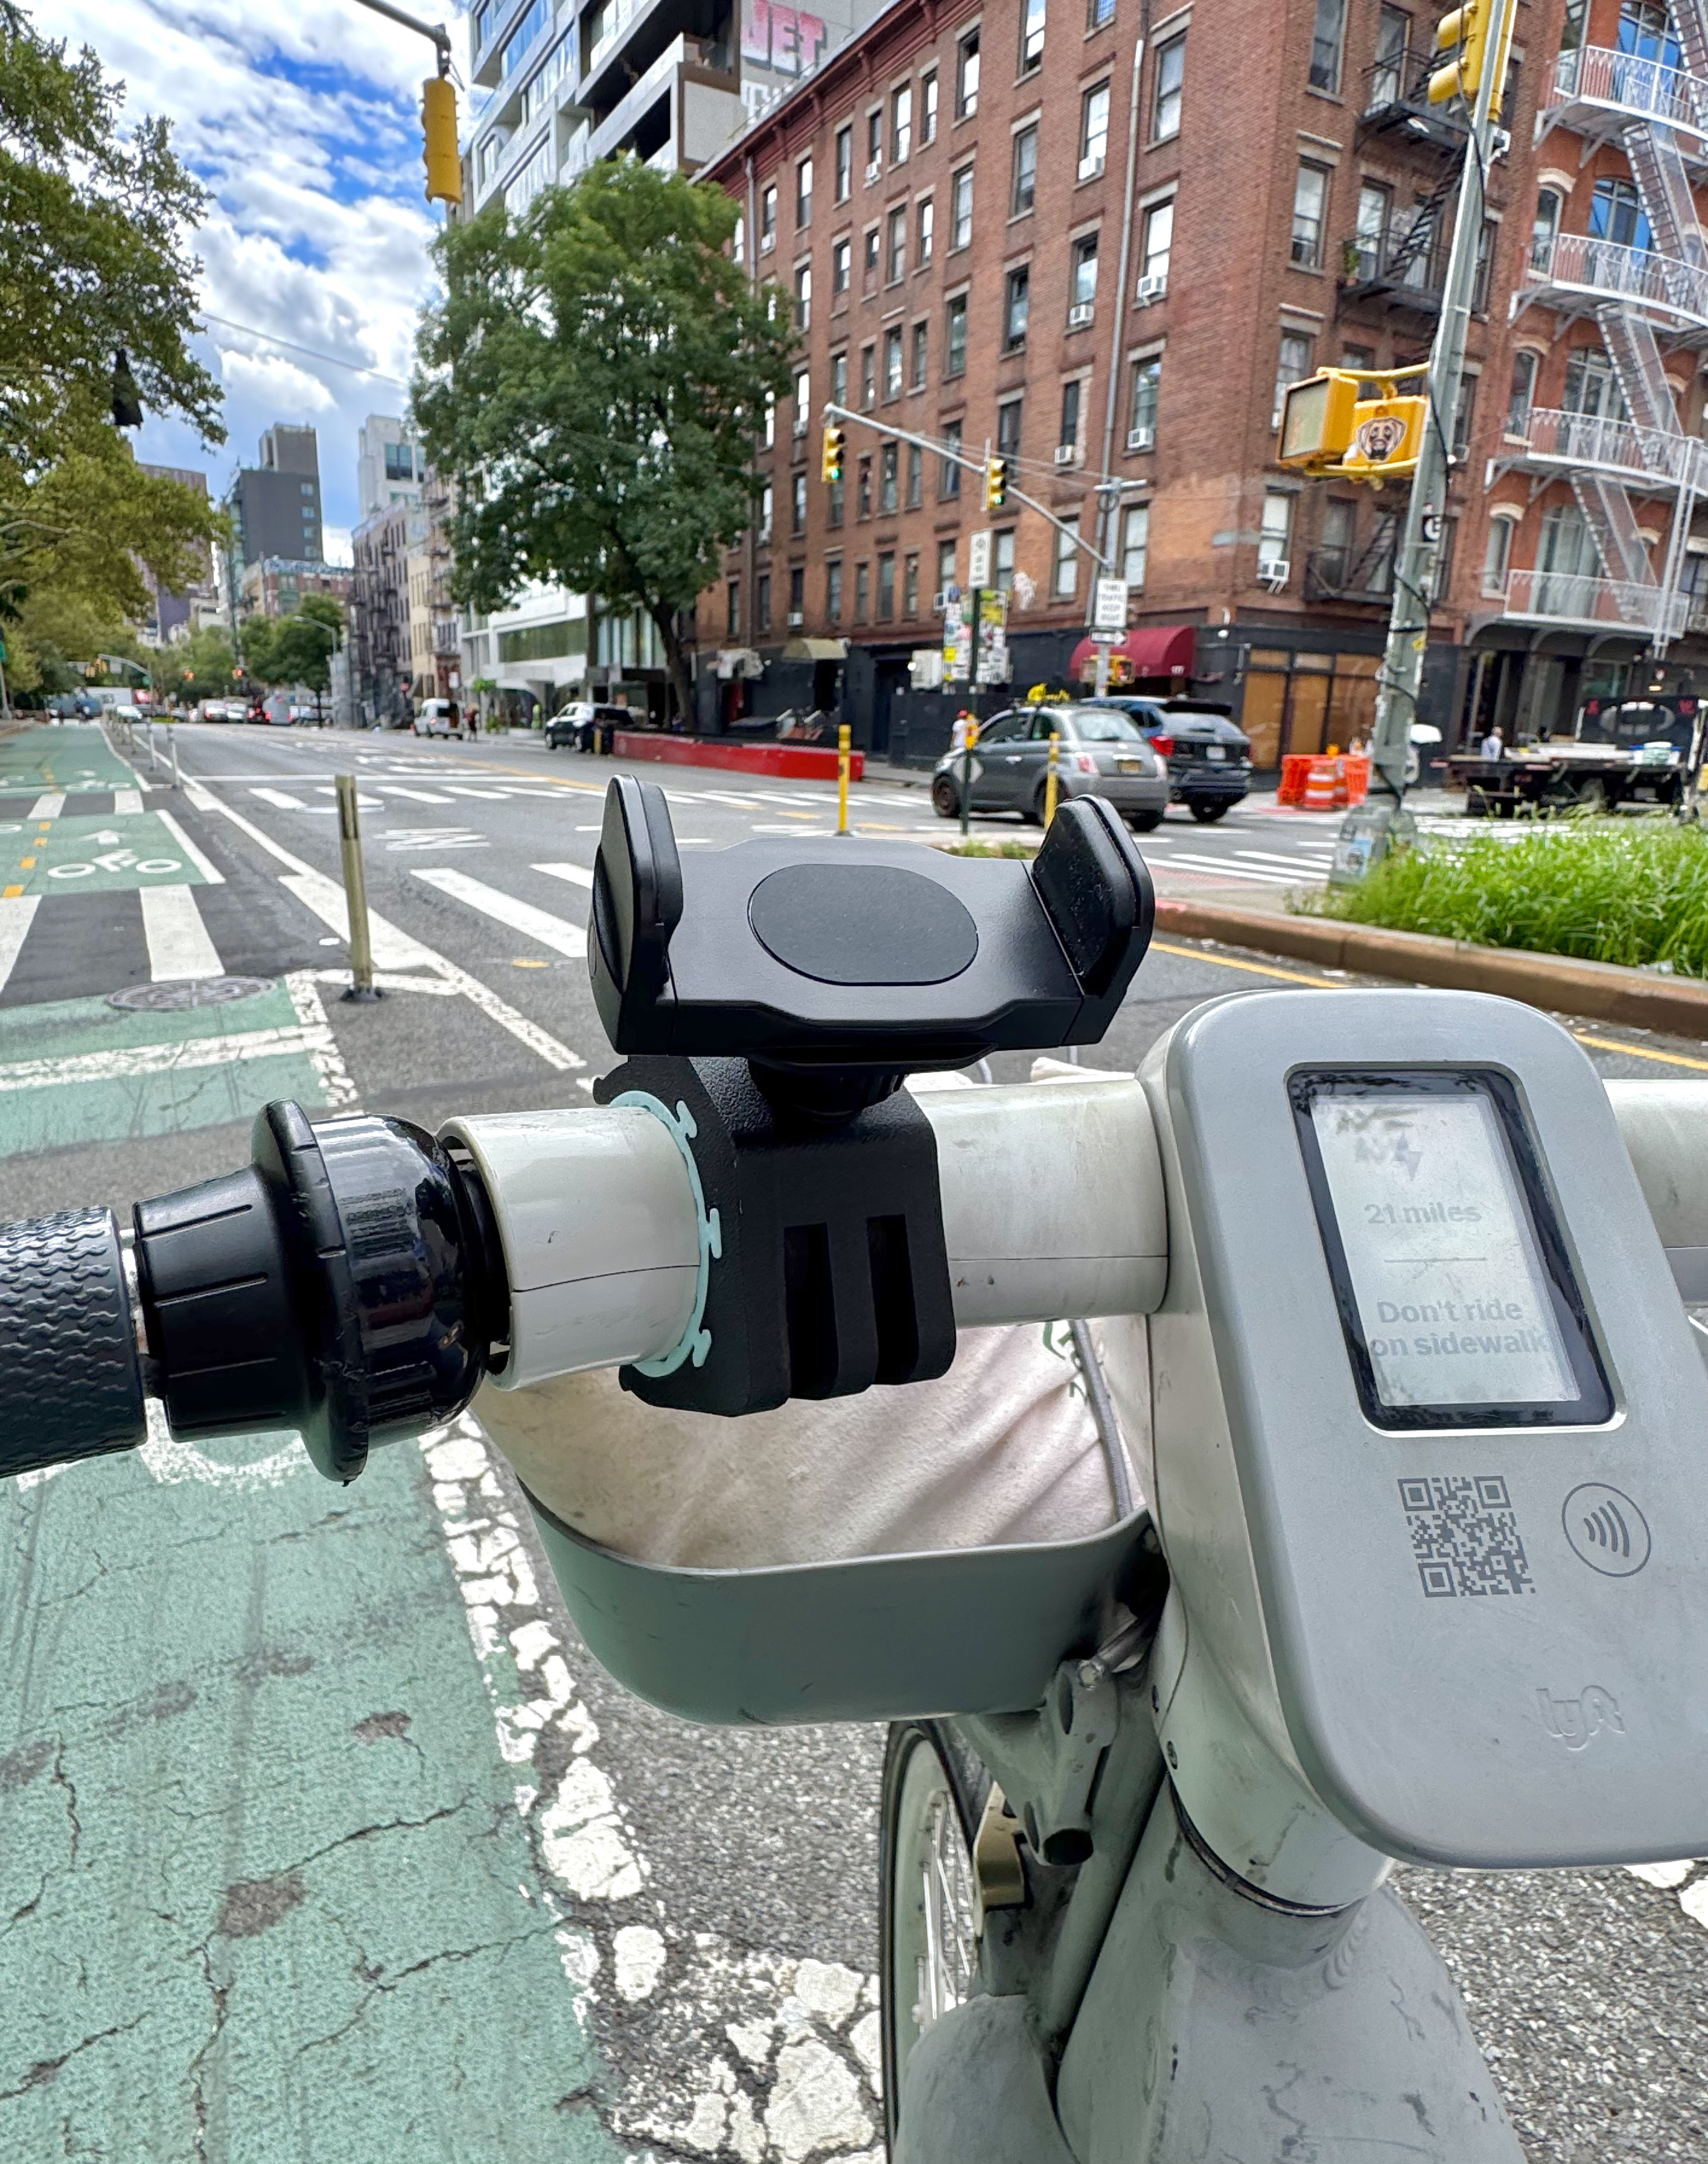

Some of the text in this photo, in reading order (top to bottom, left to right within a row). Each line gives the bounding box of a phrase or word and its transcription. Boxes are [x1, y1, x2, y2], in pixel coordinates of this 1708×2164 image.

[1364, 1201, 1482, 1224] 21 miles
[1377, 1298, 1523, 1323] Don't ride
[1368, 1330, 1549, 1357] on sidewalk
